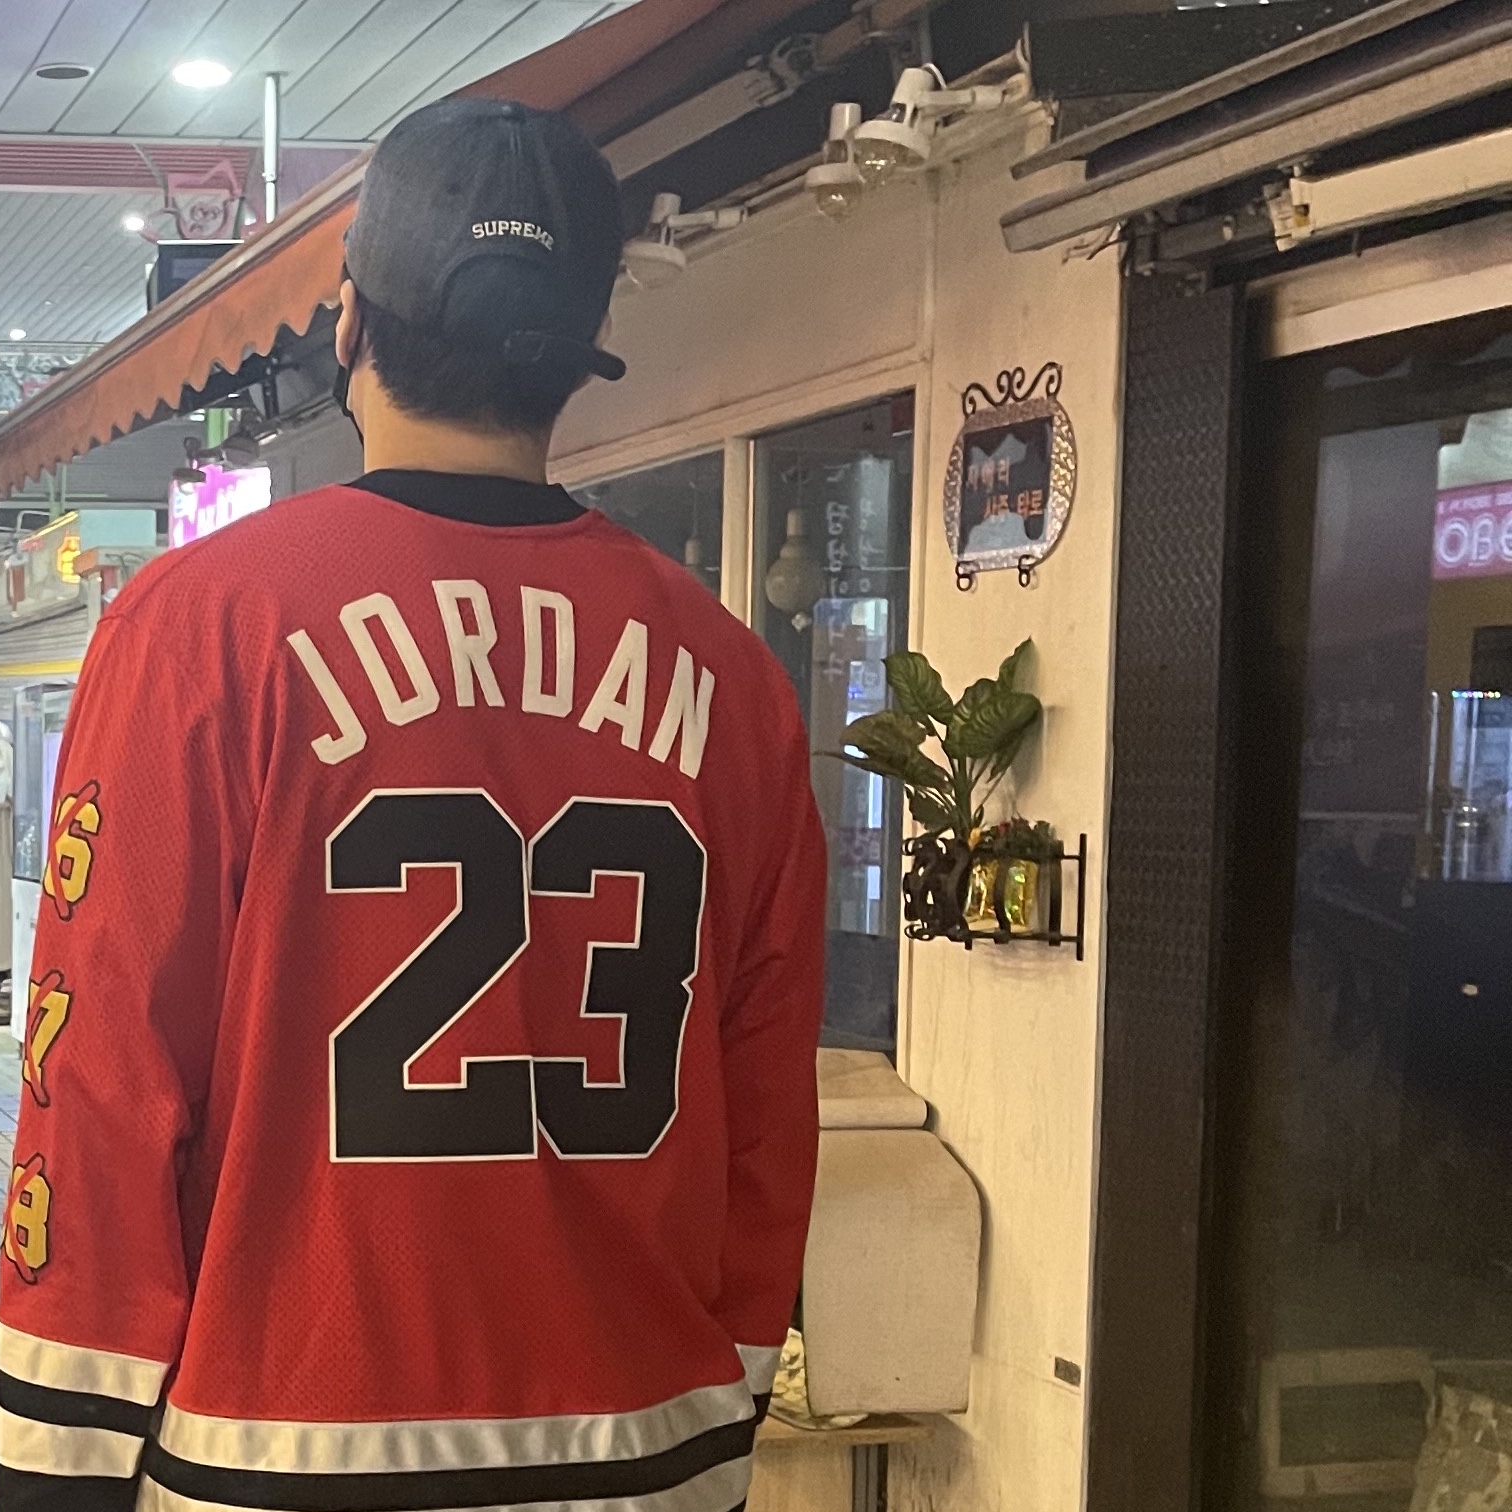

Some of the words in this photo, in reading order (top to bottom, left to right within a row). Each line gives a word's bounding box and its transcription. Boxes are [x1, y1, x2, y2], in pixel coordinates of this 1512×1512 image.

[287, 579, 715, 779] JORDAN
[43, 793, 102, 905] 6
[325, 787, 708, 1163] 23
[5, 1162, 53, 1270] 8
